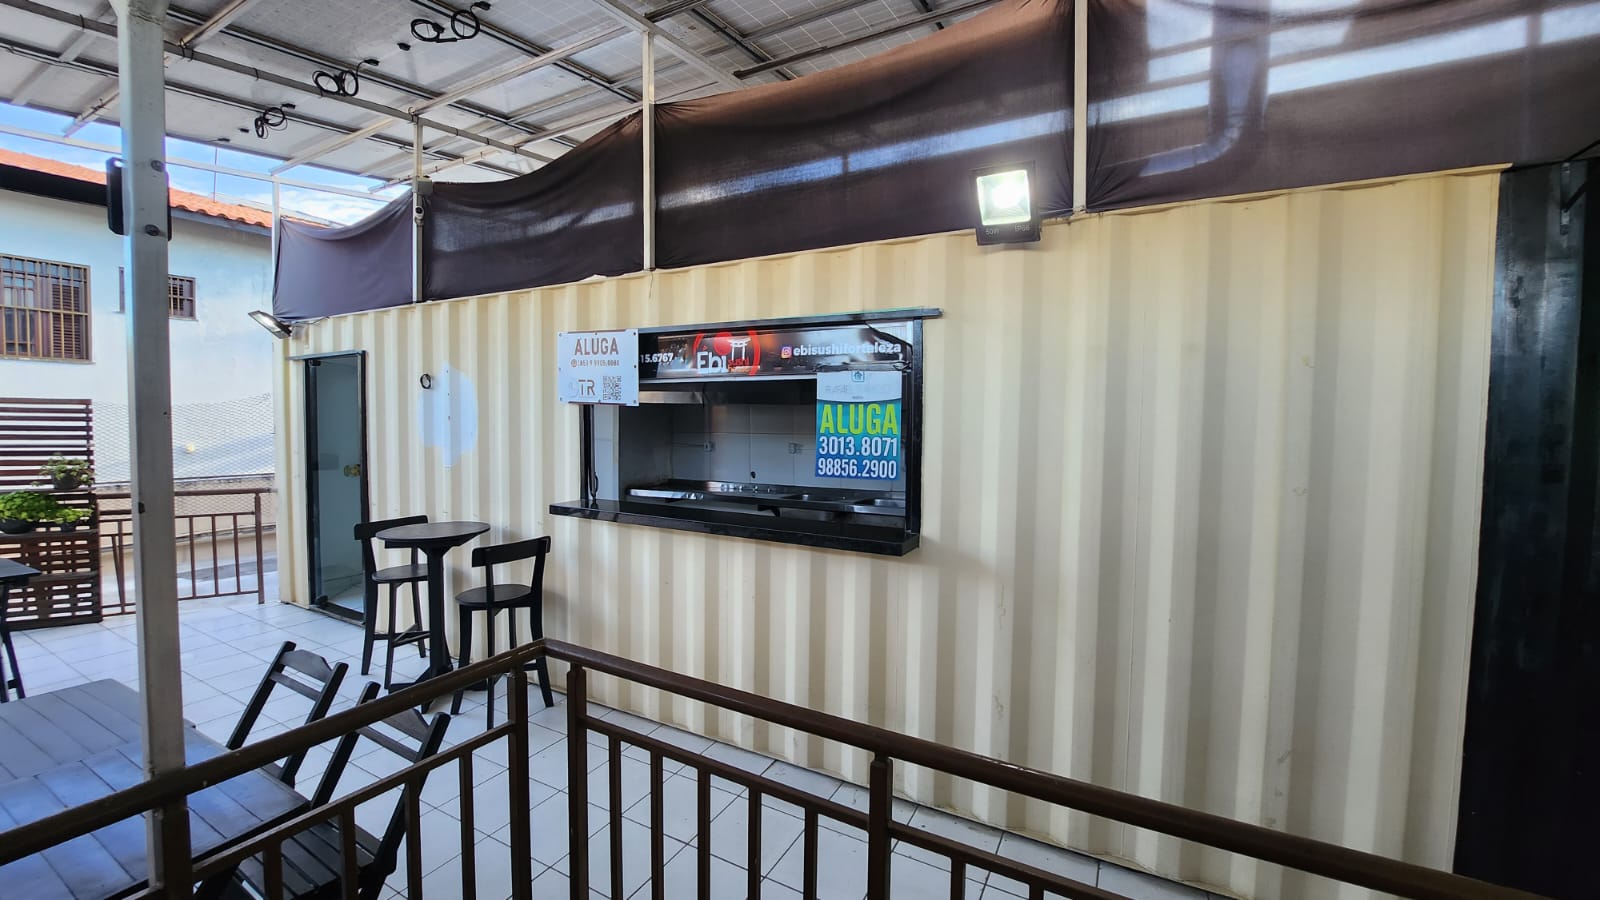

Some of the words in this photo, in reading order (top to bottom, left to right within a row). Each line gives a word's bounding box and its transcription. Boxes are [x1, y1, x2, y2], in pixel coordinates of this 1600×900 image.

[574, 336, 619, 356] ALUGA
[820, 404, 897, 434] ALUGA
[819, 436, 896, 456] 3013.8071
[818, 458, 896, 478] 98856.2900
